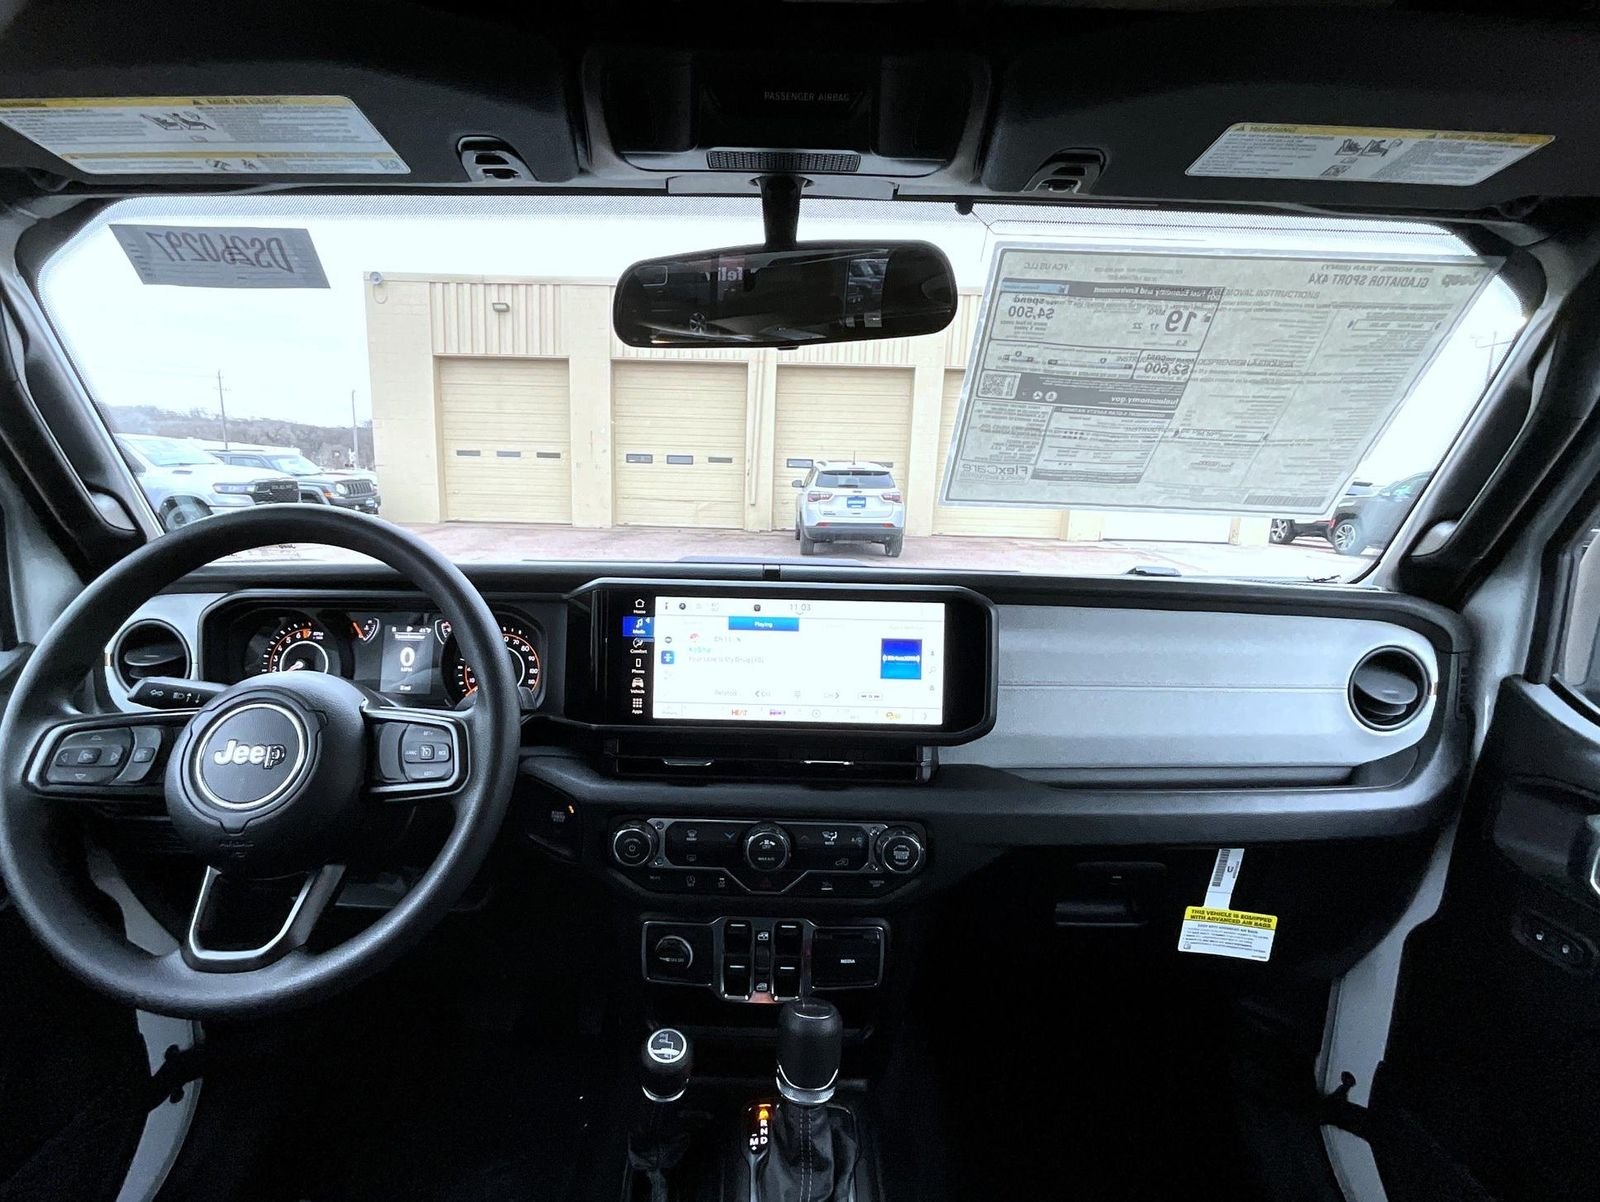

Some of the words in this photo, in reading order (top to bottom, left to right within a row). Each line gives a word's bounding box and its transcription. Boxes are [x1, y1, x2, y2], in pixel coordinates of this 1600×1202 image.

[764, 91, 814, 100] PASSENGER
[818, 92, 849, 101] AIRBAG
[1256, 288, 1320, 299] INSTRUCTIONS
[754, 621, 774, 629] Playing
[399, 646, 415, 667] 0
[529, 667, 538, 675] 100
[213, 739, 287, 769] Jeep
[1206, 910, 1232, 918] VEHICLE
[1240, 914, 1272, 923] EQUIPPED
[1207, 916, 1241, 924] ADVANCED
[760, 1119, 768, 1127] R
[760, 1127, 769, 1136] N
[749, 1137, 759, 1146] M
[760, 1136, 769, 1145] D
